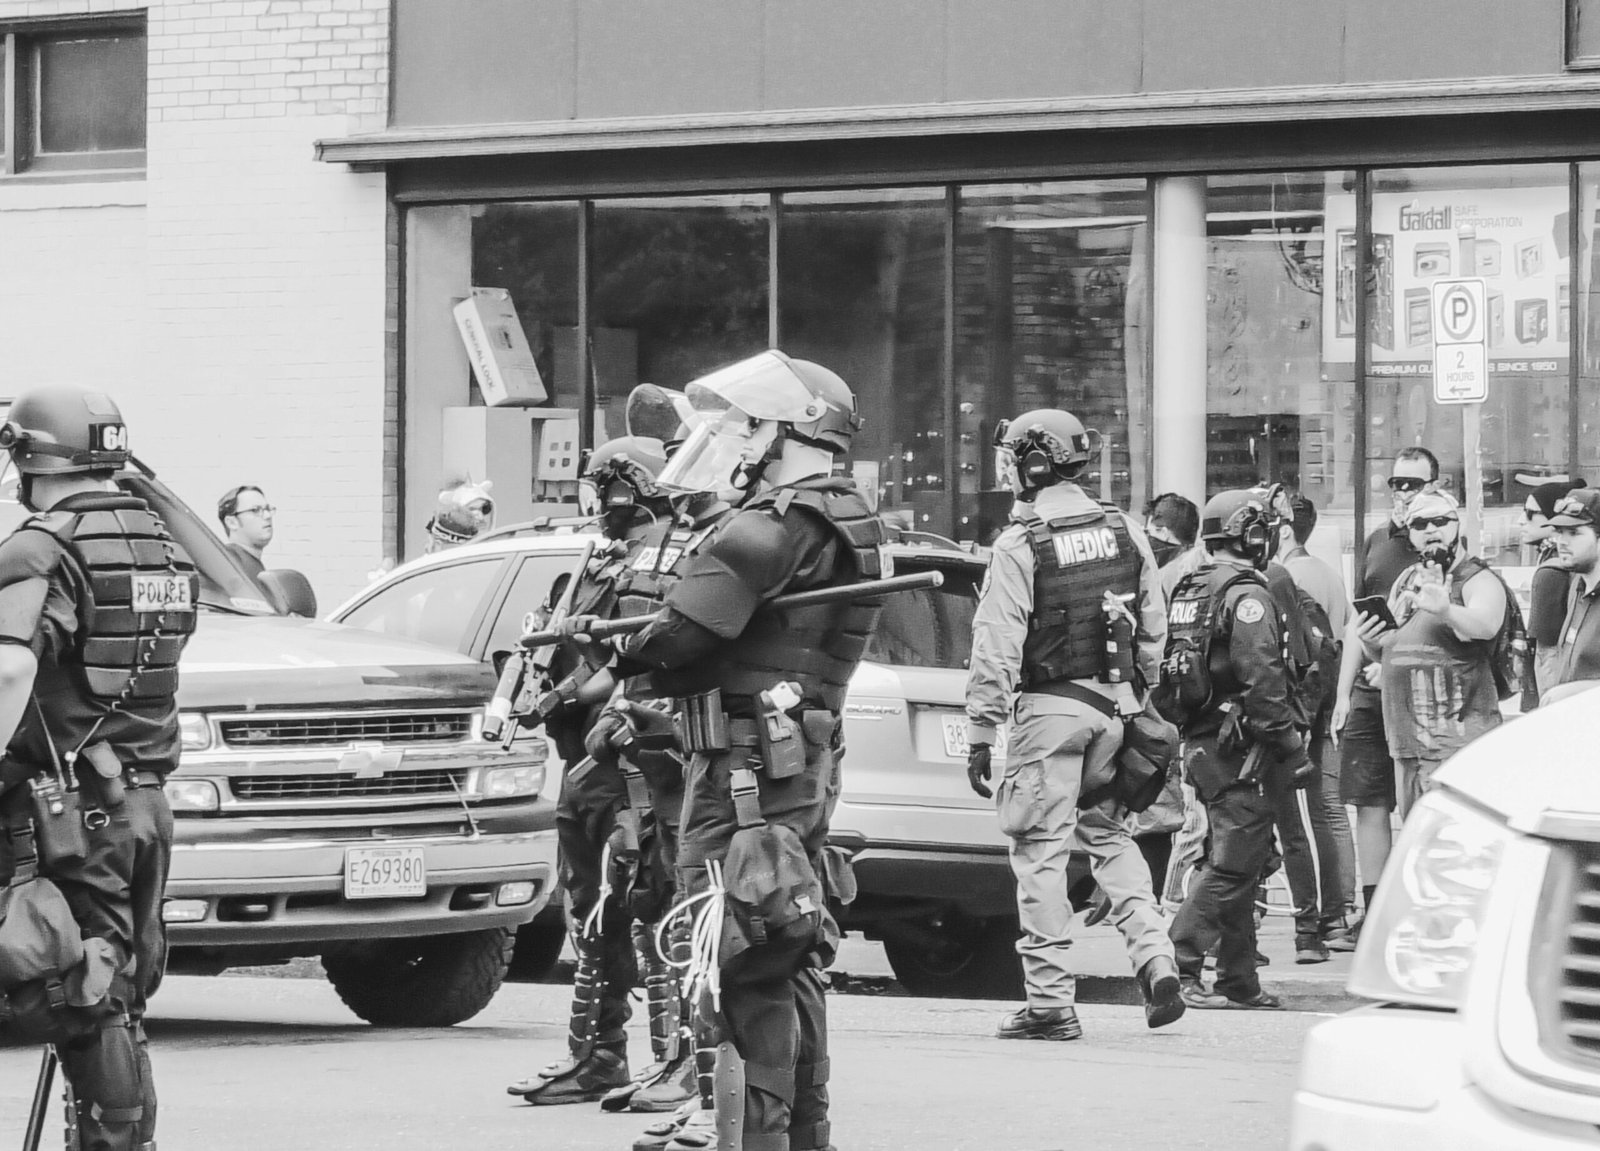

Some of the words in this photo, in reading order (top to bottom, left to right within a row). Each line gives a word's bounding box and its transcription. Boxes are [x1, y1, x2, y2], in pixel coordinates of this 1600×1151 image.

[1454, 205, 1479, 216] SAFE
[1452, 297, 1469, 329] P
[1456, 350, 1465, 369] 2
[1497, 362, 1529, 372] SINCE
[1446, 372, 1475, 383] HOURS
[1054, 527, 1117, 566] MEDIC
[137, 582, 187, 603] POLICE
[846, 703, 902, 716] SUBARU
[350, 857, 422, 885] E269380
